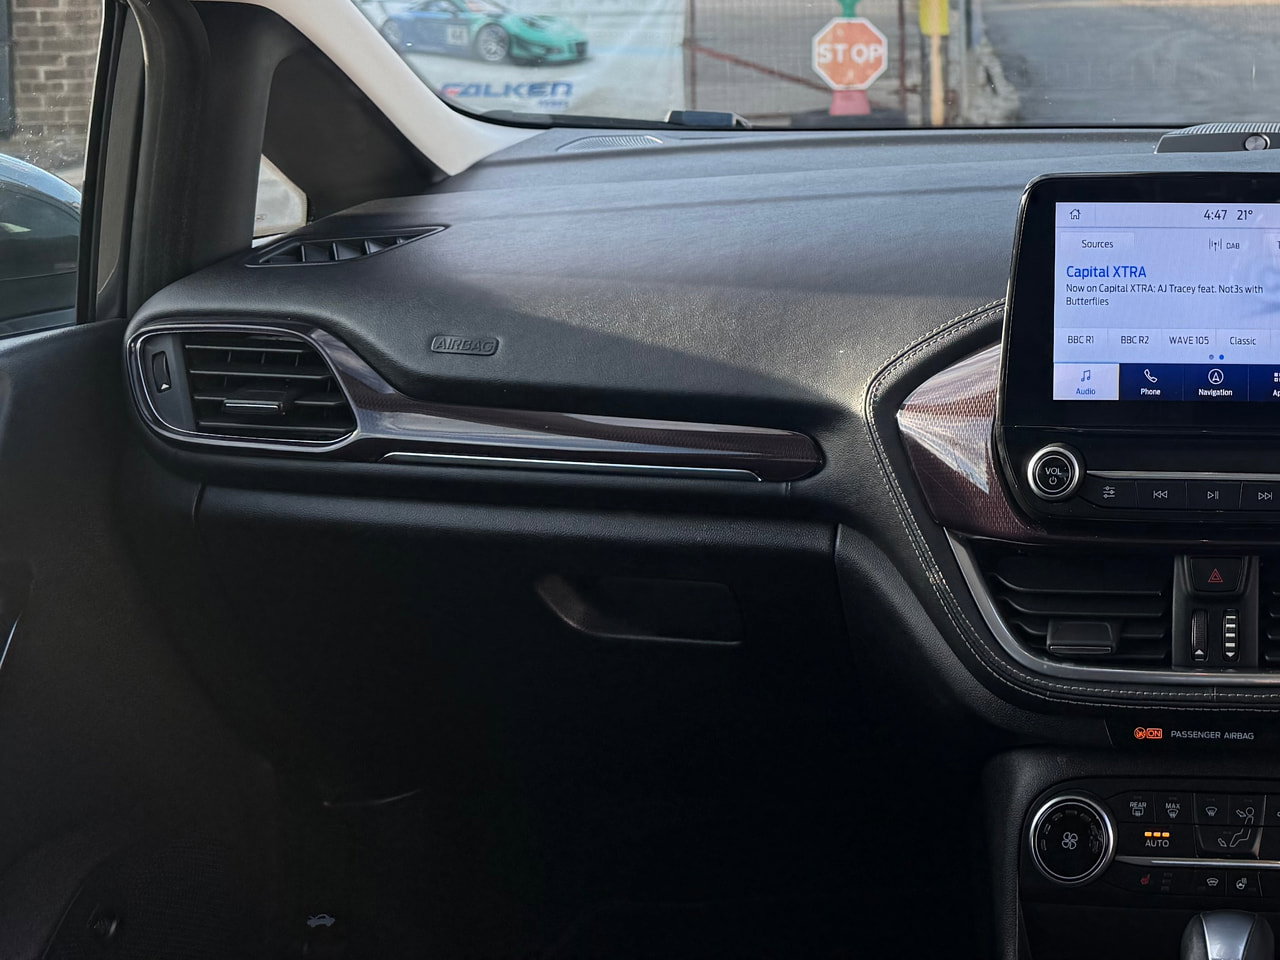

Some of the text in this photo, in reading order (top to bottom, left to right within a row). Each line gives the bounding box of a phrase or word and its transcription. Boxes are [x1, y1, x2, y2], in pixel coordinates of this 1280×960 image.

[817, 43, 884, 64] STOP
[1204, 209, 1227, 221] 4:47
[1237, 209, 1253, 221] 21°
[1081, 239, 1114, 249] Sources
[1066, 265, 1147, 279] Capital XTRA
[1066, 283, 1263, 295] Now on Capital XTRA: AJ Tracey feat. Not3s with
[1066, 296, 1109, 306] Butterflies
[1067, 335, 1094, 344] BBC R1
[1120, 336, 1149, 345] BBC R2
[1169, 336, 1209, 345] WAVE 105
[1230, 336, 1256, 346] Classic
[436, 338, 495, 353] AIRBAG
[1076, 387, 1096, 396] Audio
[1140, 388, 1161, 396] Phone
[1198, 389, 1233, 397] Navigation
[1045, 467, 1062, 475] VOL
[1170, 730, 1221, 739] PASSENGER
[1223, 731, 1255, 740] AIRBAG
[1145, 839, 1169, 847] AUTO
